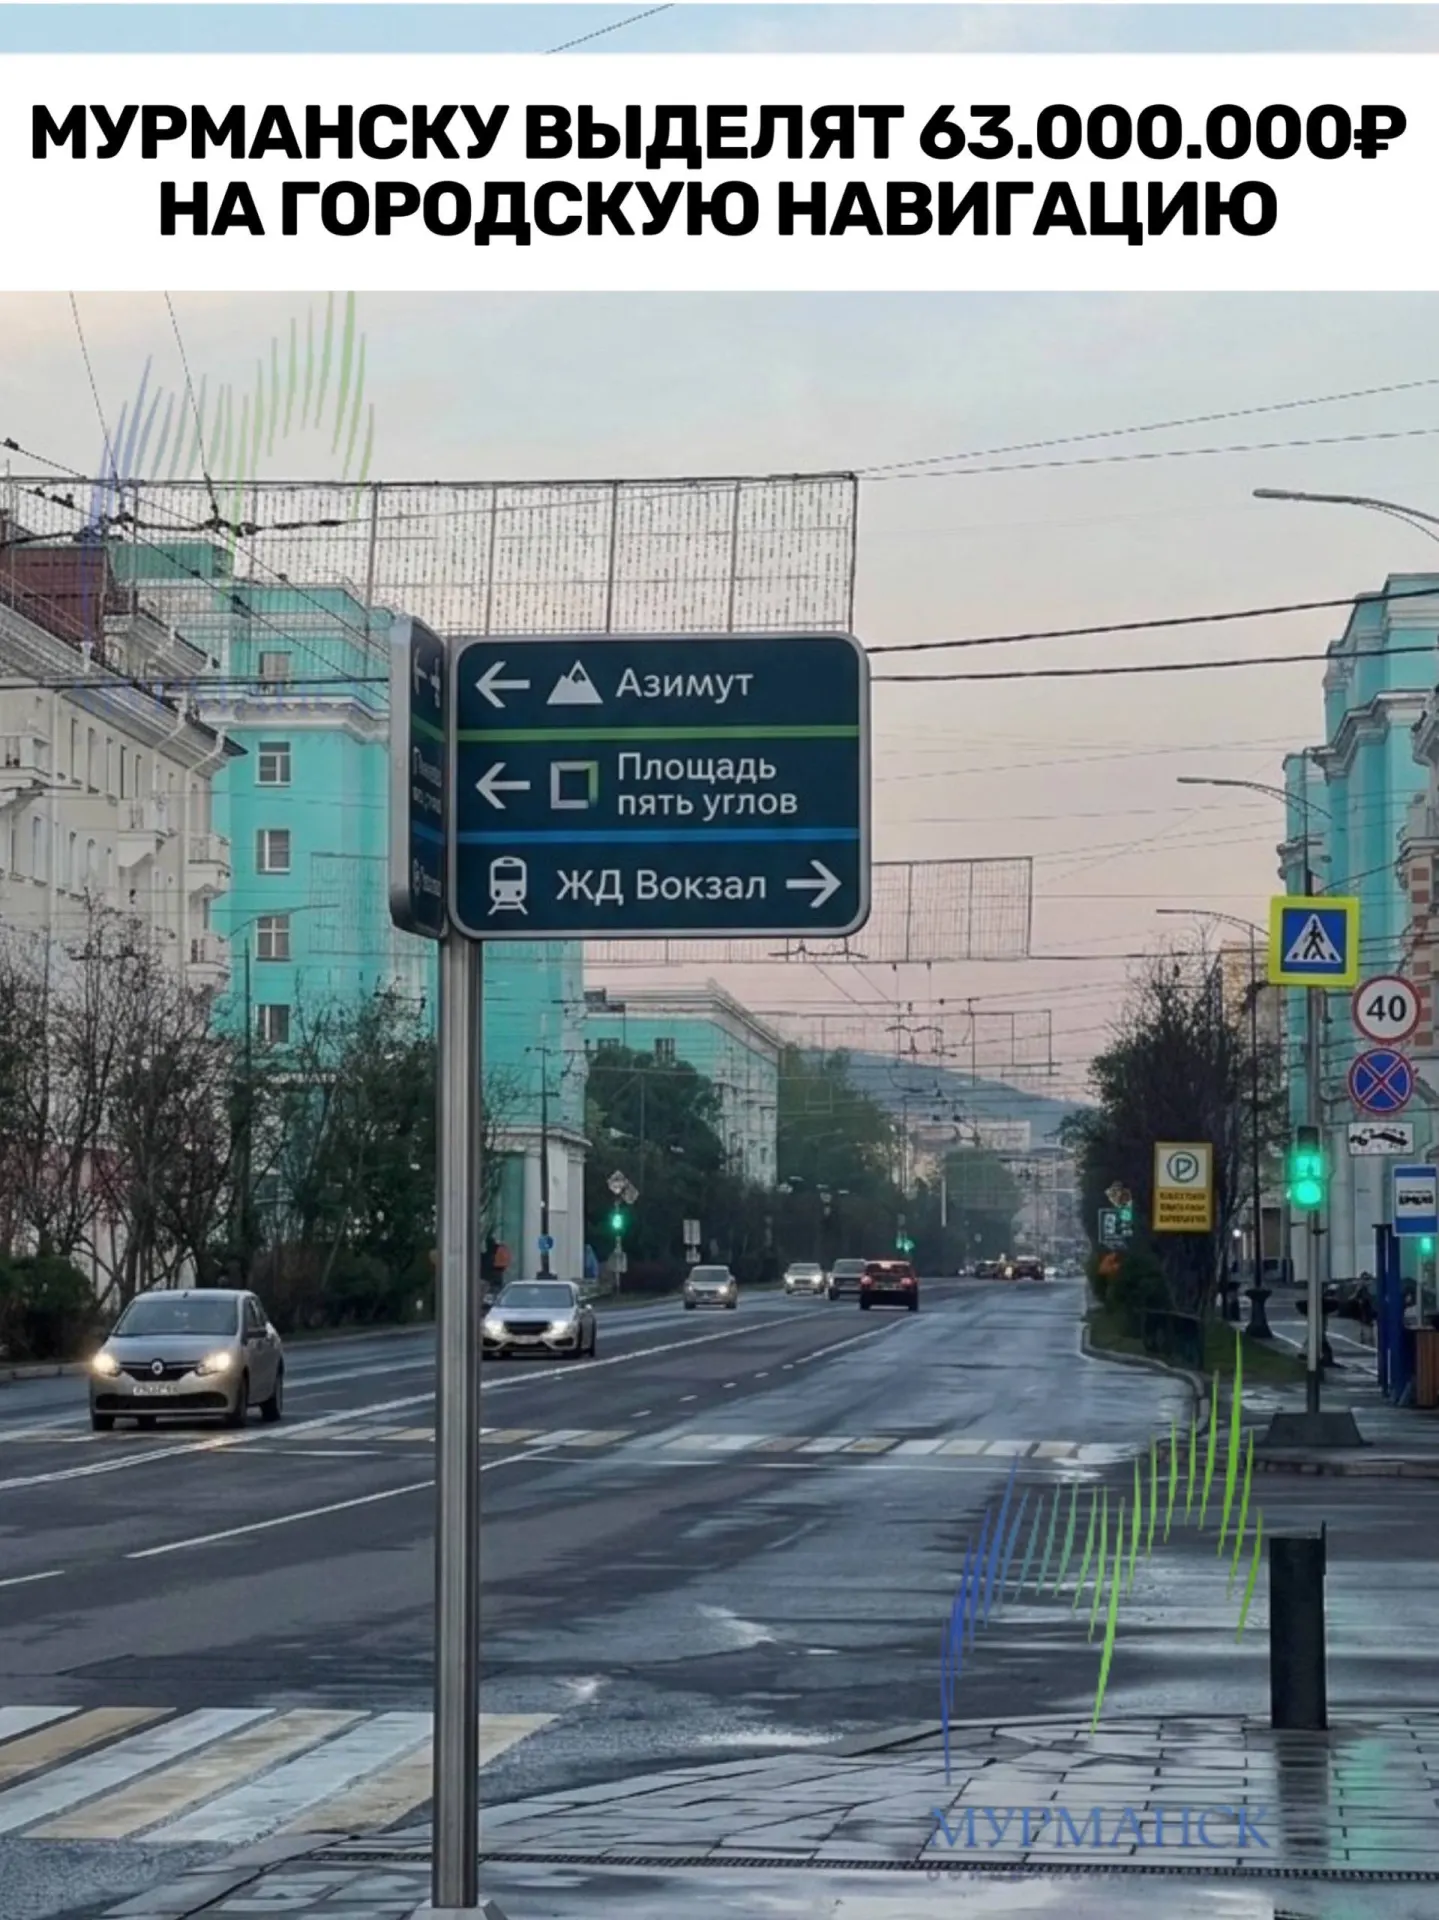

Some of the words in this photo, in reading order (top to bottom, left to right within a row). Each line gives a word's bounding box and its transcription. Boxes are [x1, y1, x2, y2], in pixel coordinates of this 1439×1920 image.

[615, 667, 754, 705] Азимут
[617, 752, 777, 785] Площадь
[617, 794, 693, 816] пять
[703, 793, 798, 821] углов
[555, 869, 624, 906] ЖД
[637, 870, 767, 901] Вокзал
[1366, 994, 1407, 1022] 40
